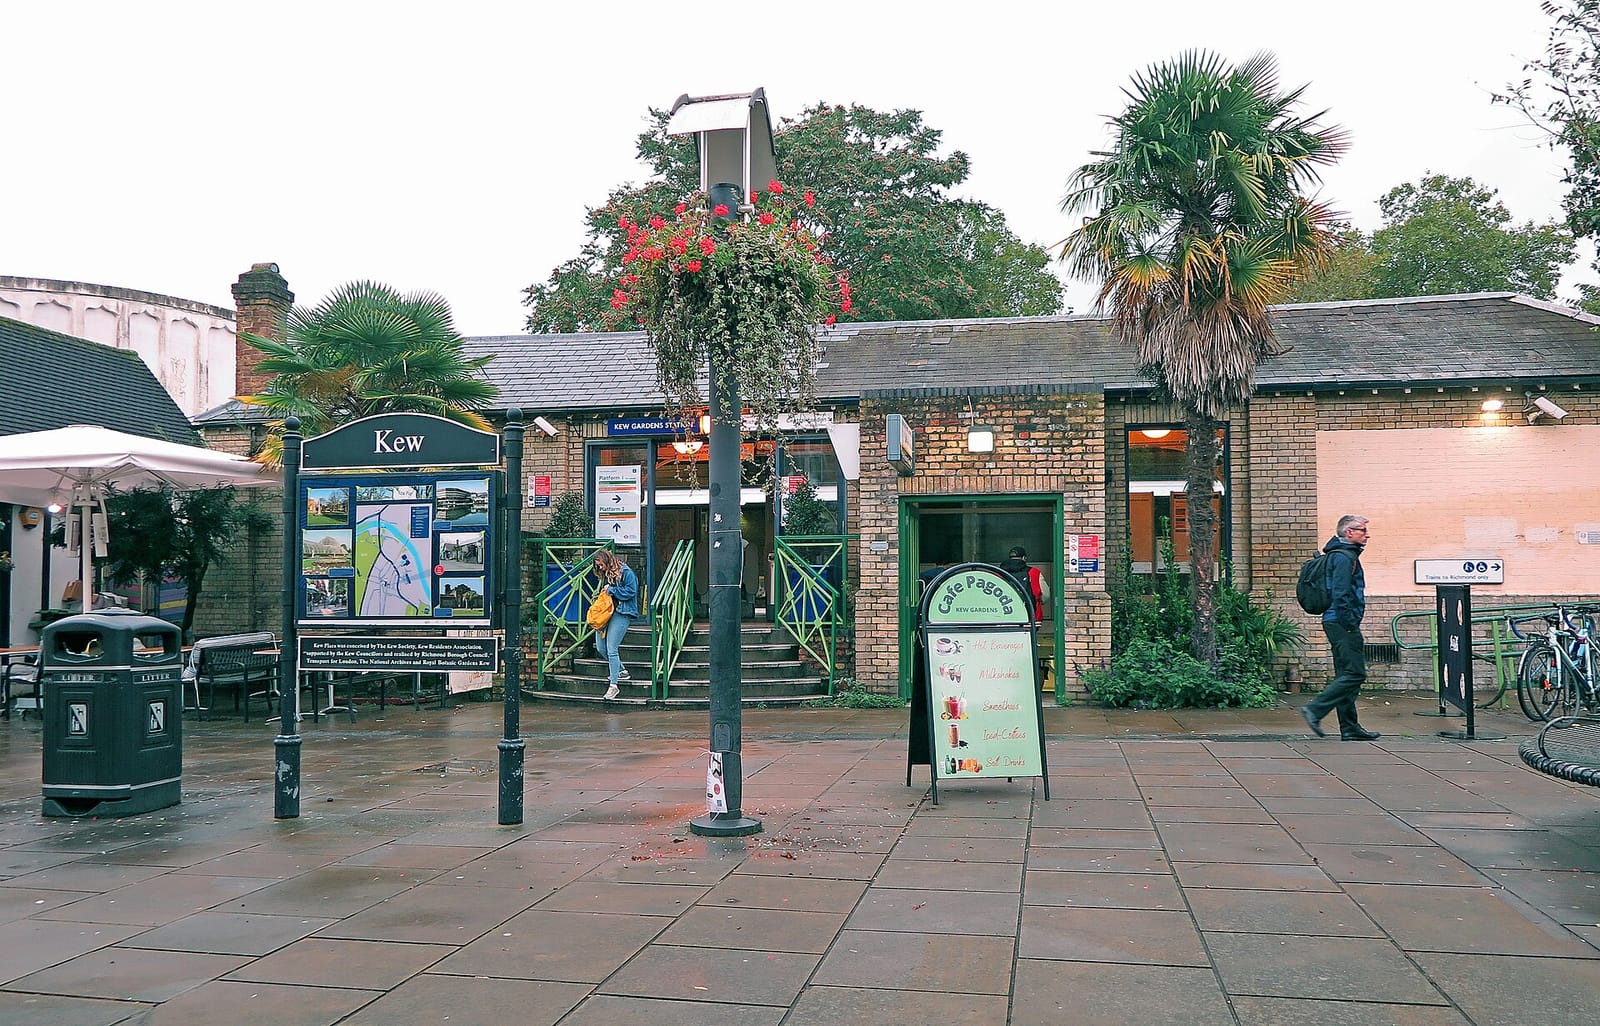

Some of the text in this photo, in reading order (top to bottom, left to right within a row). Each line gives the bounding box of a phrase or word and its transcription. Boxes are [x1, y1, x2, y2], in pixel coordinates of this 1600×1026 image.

[374, 430, 424, 453] Kew
[966, 576, 1013, 615] Pagoda
[62, 673, 95, 681] LITTER
[979, 668, 1020, 679] Milkshakes
[982, 698, 1020, 711] Smoothies
[1003, 756, 1025, 766] Drinks
